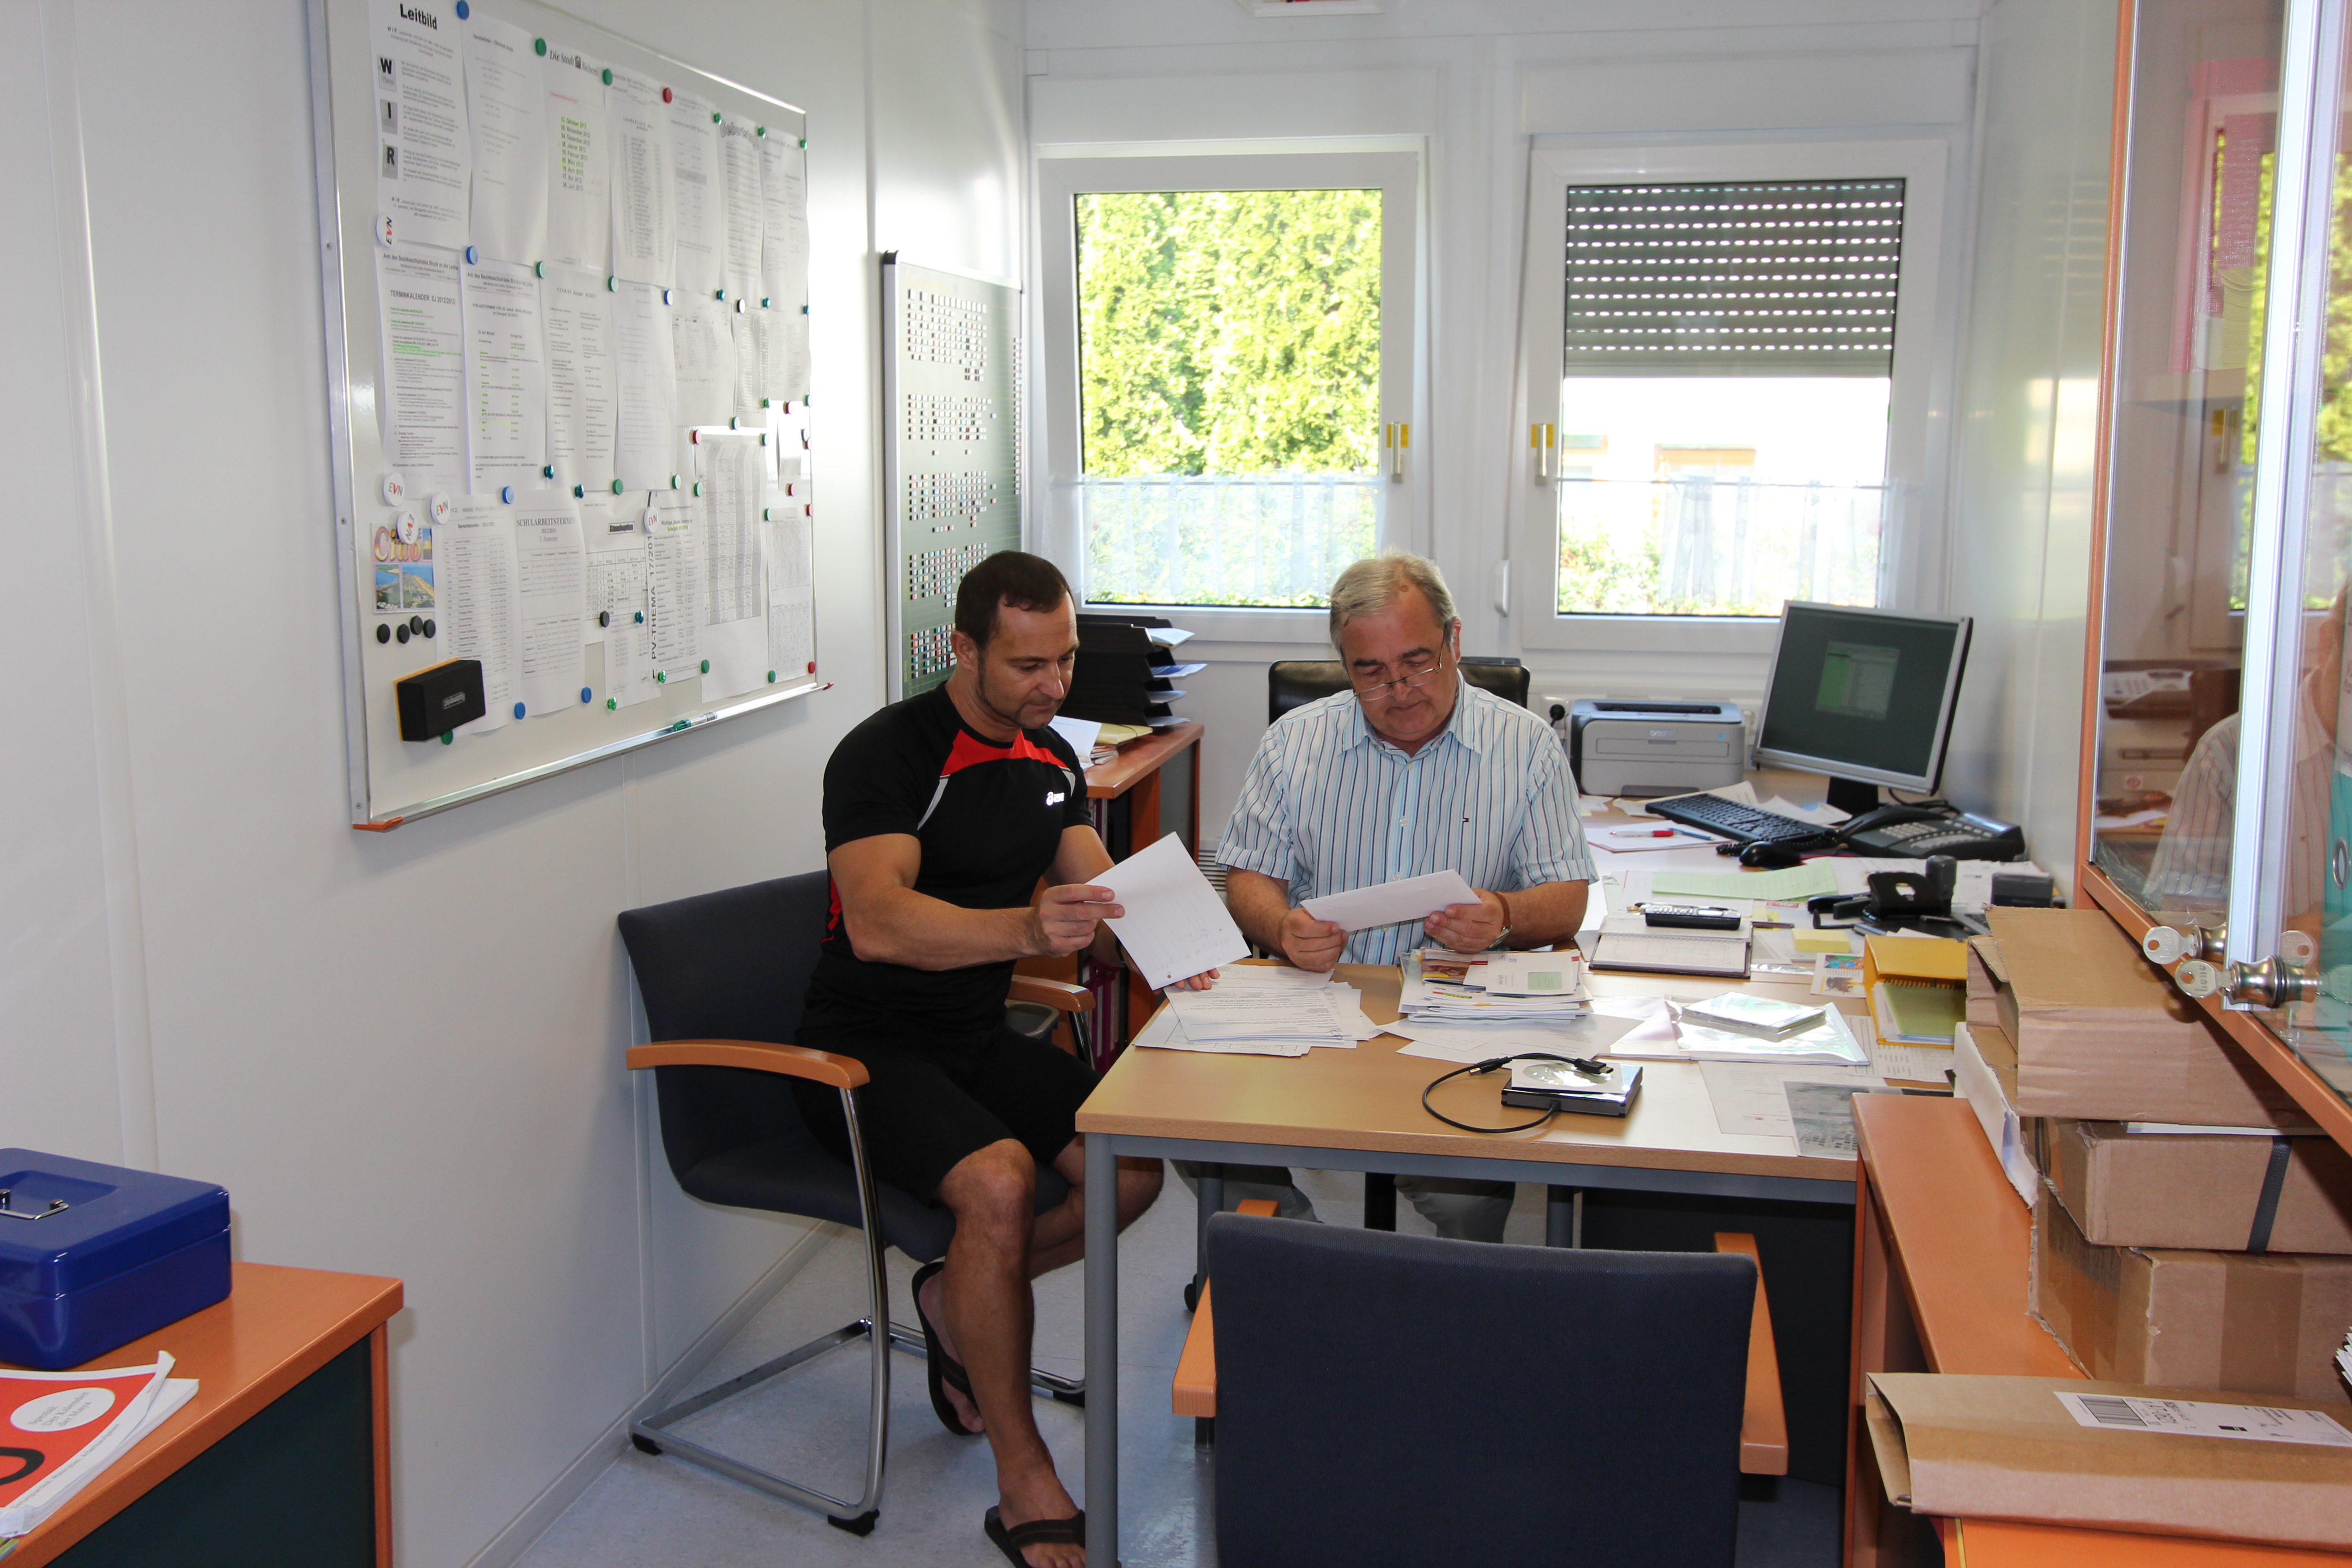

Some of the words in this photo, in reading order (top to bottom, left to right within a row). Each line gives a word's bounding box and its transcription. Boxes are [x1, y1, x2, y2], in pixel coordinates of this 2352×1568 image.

[400, 3, 437, 30] Leitbild
[549, 50, 560, 62] Die
[380, 58, 392, 74] W
[387, 101, 392, 119] I
[387, 147, 395, 166] R
[390, 289, 430, 302] TERMINKALENDER
[389, 482, 403, 496] EVN
[436, 500, 448, 516] EVN
[405, 514, 415, 541] EVN
[517, 517, 578, 527] SCHULARBEITSTERMIN
[648, 514, 657, 526] EVN
[2195, 964, 2208, 993] bene
